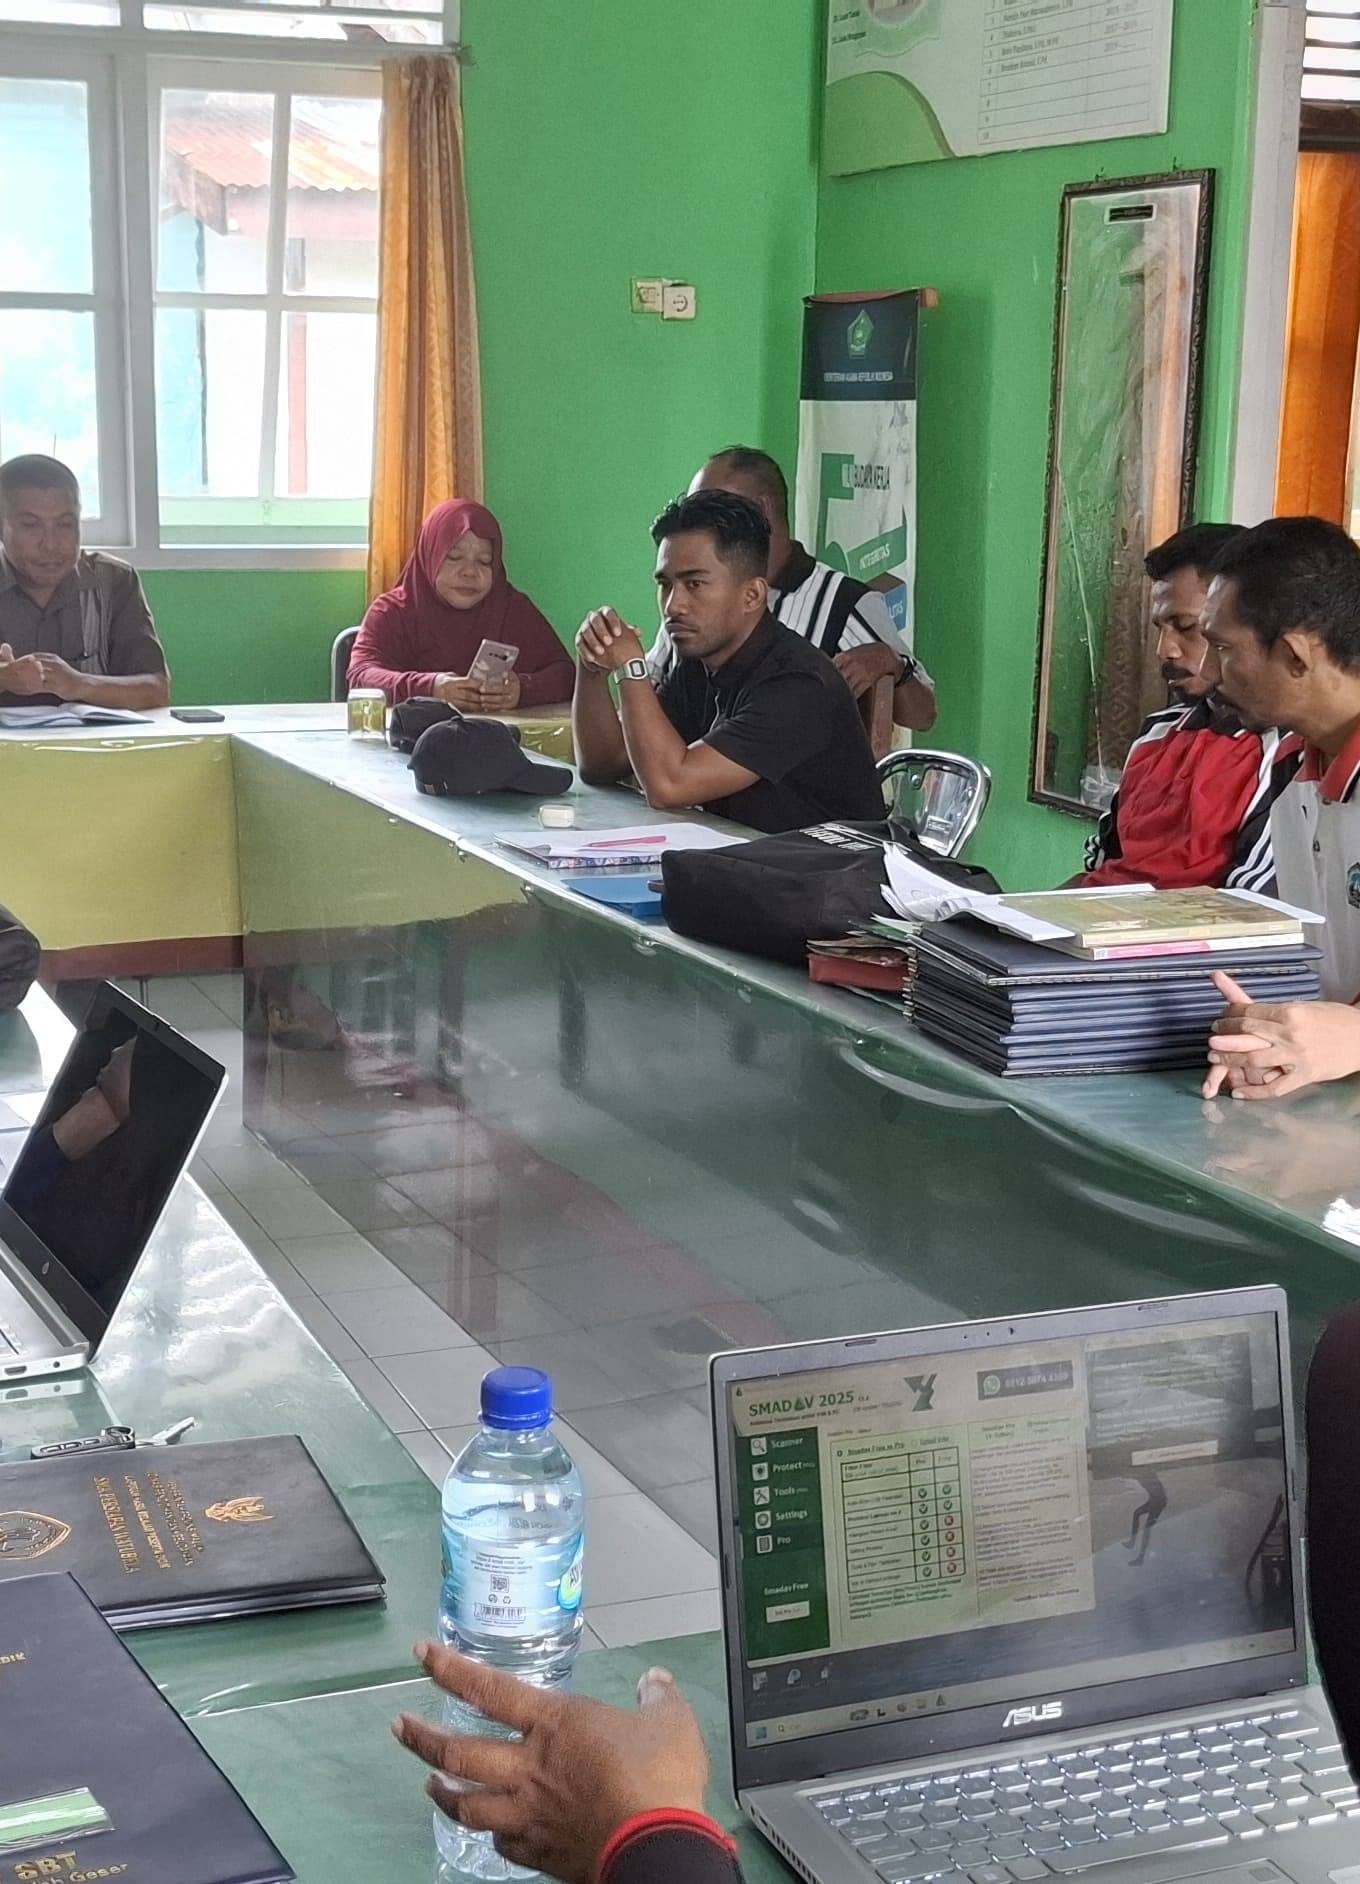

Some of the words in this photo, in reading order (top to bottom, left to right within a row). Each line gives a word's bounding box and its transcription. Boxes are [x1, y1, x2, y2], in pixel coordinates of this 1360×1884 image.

[819, 1390, 854, 1407] 2025
[771, 1437, 804, 1449] Scanner
[772, 1461, 802, 1473] Protect
[774, 1487, 795, 1497] Tools
[776, 1509, 808, 1521] Settings
[777, 1536, 791, 1545] Pro
[1002, 1701, 1062, 1728] ASUS
[15, 1850, 77, 1880] SBT
[69, 1863, 128, 1882] Geser
